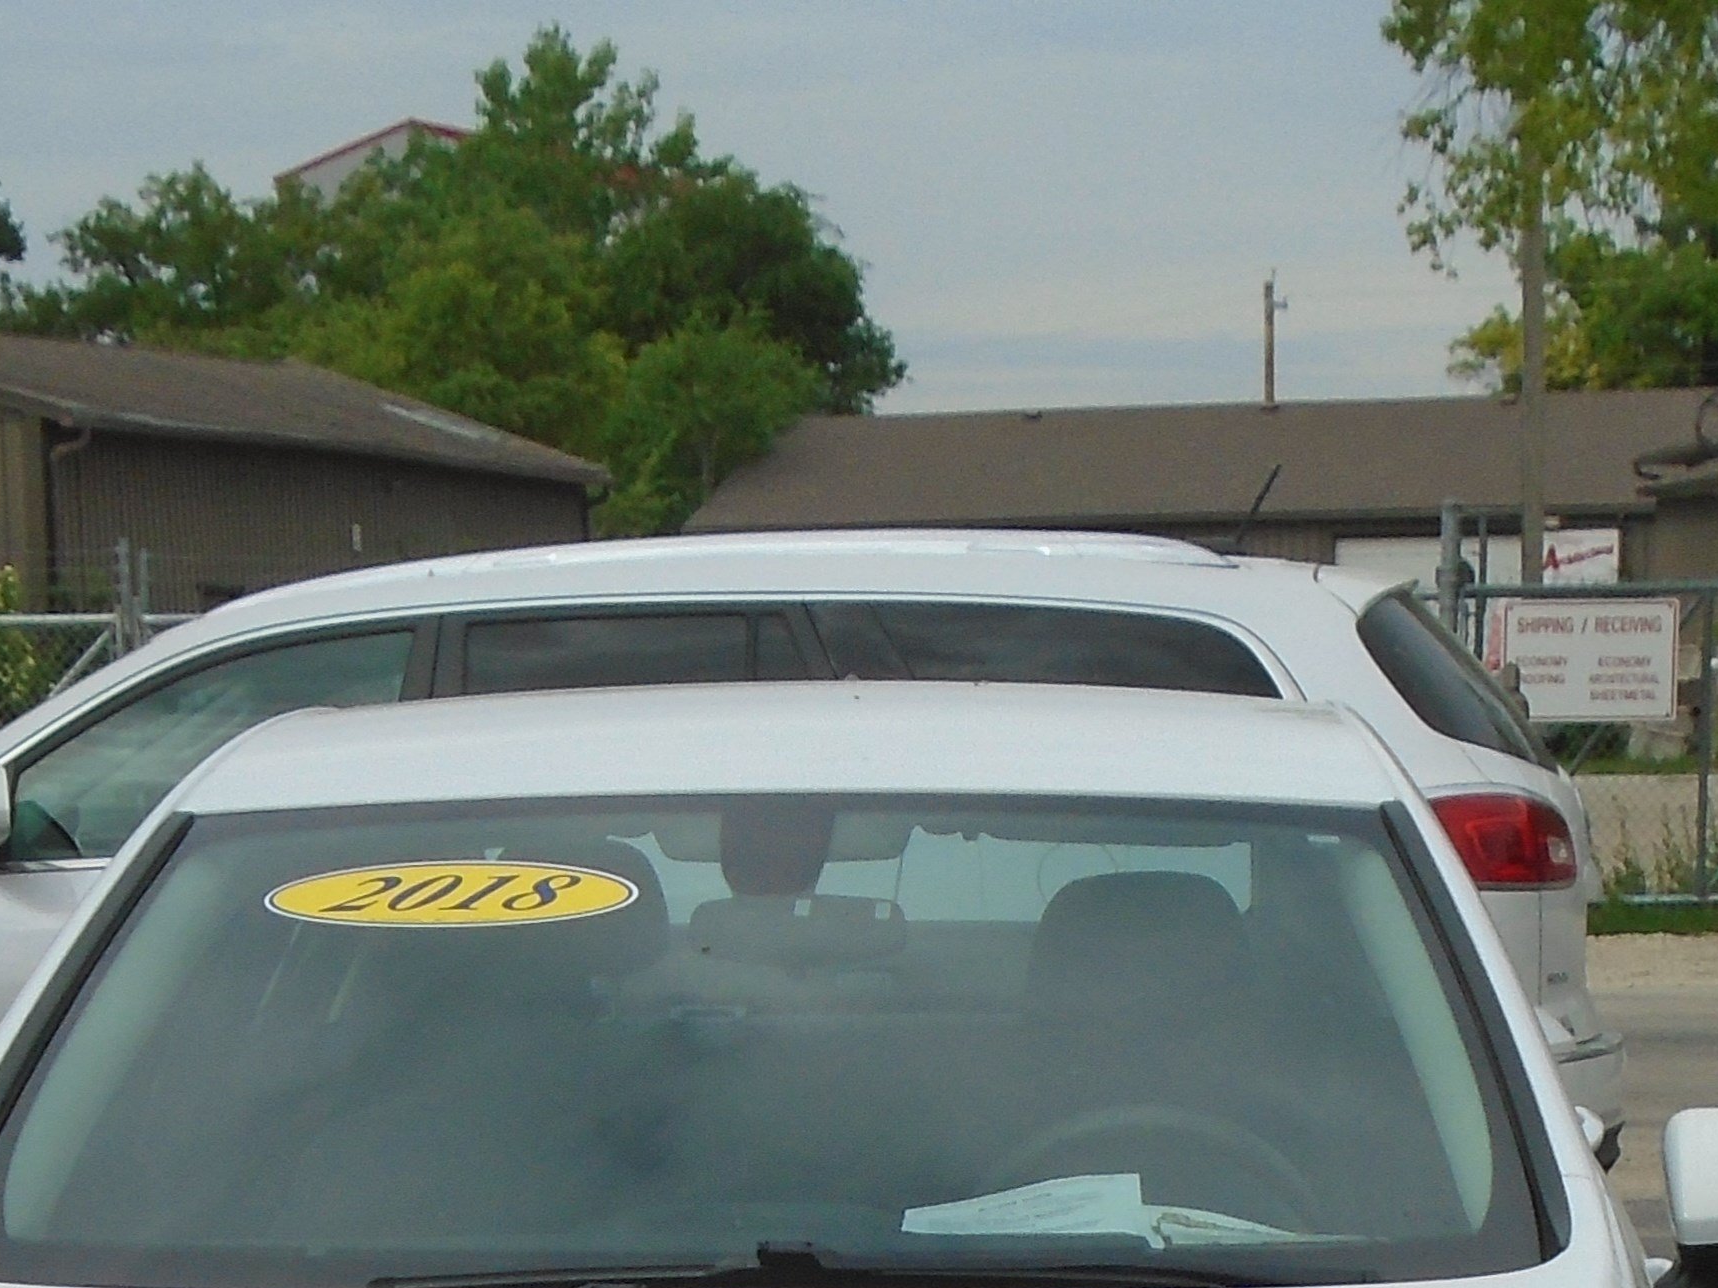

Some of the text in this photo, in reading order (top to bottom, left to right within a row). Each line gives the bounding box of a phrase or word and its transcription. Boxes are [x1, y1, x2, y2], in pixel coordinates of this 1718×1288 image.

[1517, 615, 1663, 635] SHIPPING / RECEIVING
[1598, 655, 1651, 668] ECONOMY
[319, 874, 582, 913] 2018
